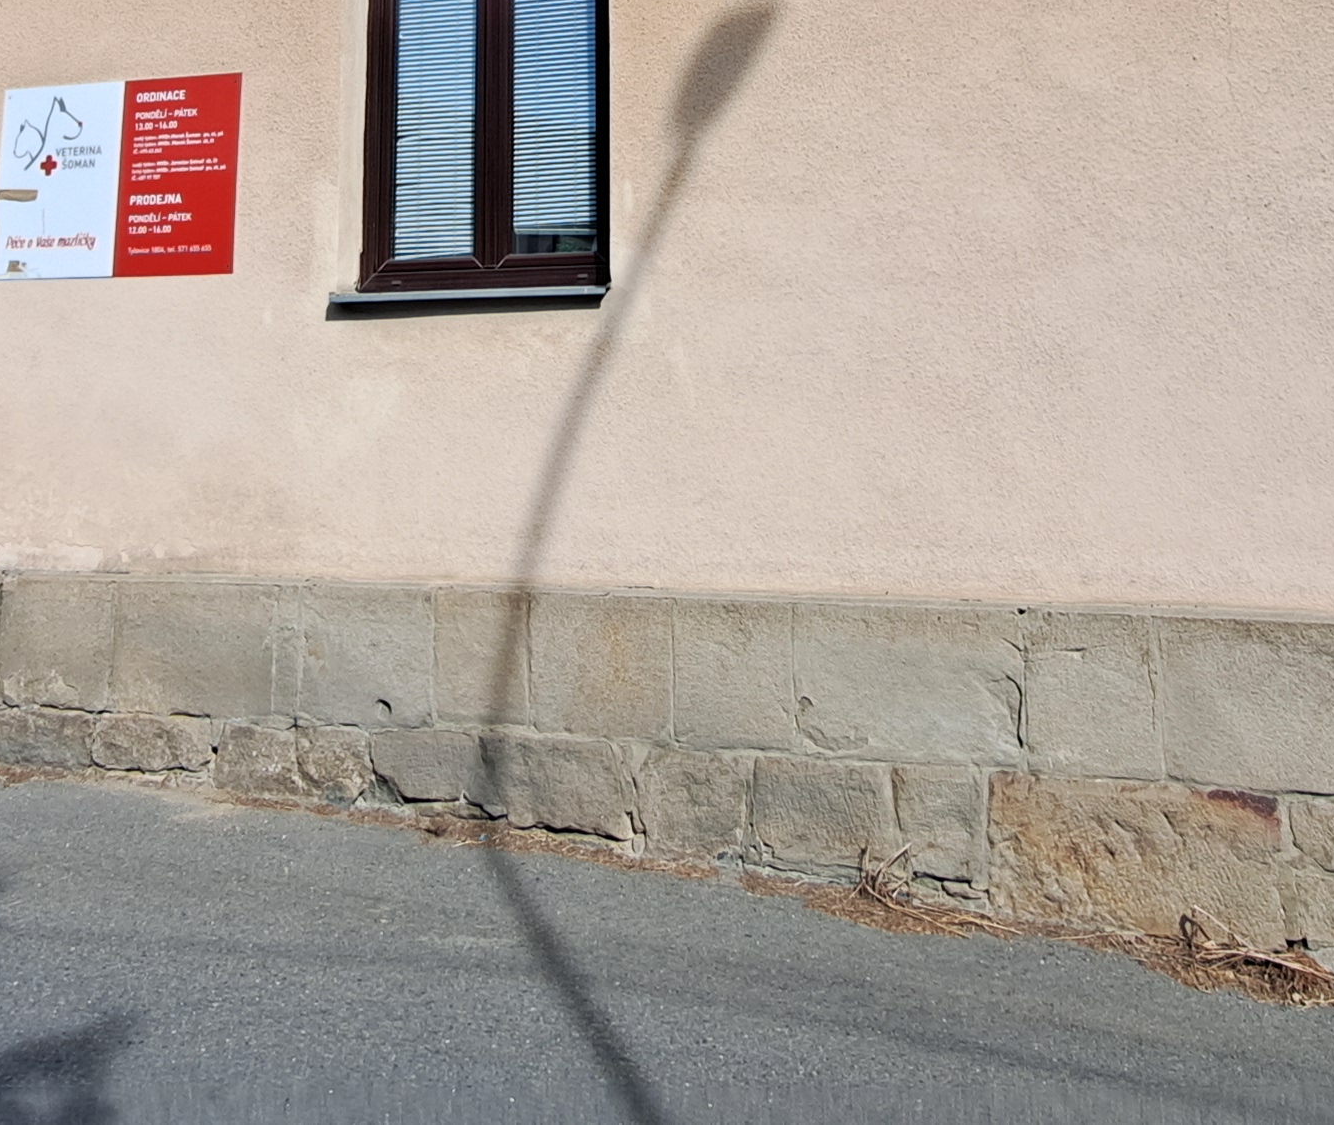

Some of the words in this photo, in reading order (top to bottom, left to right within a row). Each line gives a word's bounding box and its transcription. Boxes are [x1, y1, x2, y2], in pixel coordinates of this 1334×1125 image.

[136, 89, 186, 104] ORDINACE
[135, 108, 168, 120] PONDĚLÍ
[174, 107, 198, 118] PÁTEK
[55, 145, 102, 158] VETERINA
[61, 158, 95, 170] ŠOMAN
[129, 193, 182, 206] PRODEJNA
[129, 212, 161, 223] PONDĚLÍ
[168, 211, 192, 222] PÁTEK
[28, 240, 33, 249] o
[57, 233, 96, 251] mazlíčky
